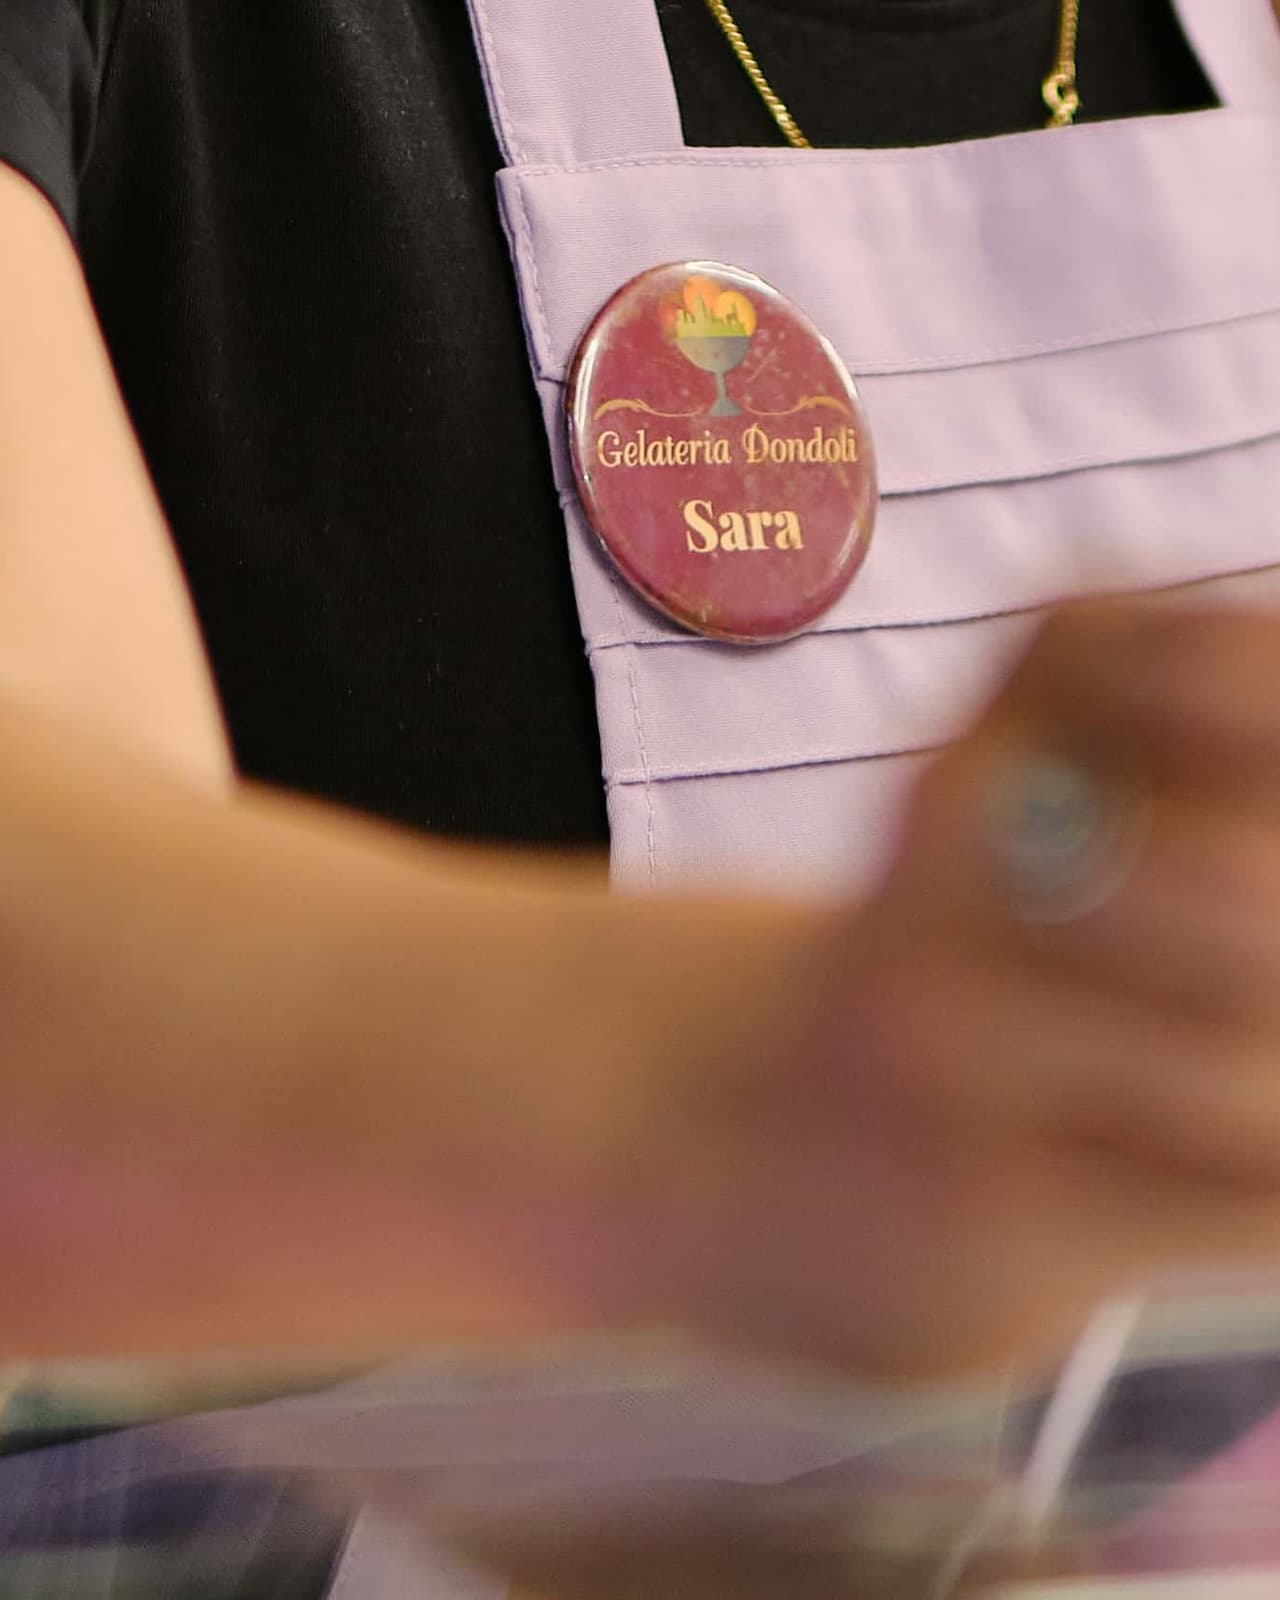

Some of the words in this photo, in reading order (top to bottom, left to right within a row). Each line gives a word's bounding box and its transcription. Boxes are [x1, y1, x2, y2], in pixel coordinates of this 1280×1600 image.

[597, 429, 732, 468] Gelateria
[742, 423, 858, 464] Dondoli
[682, 499, 804, 553] Sara
